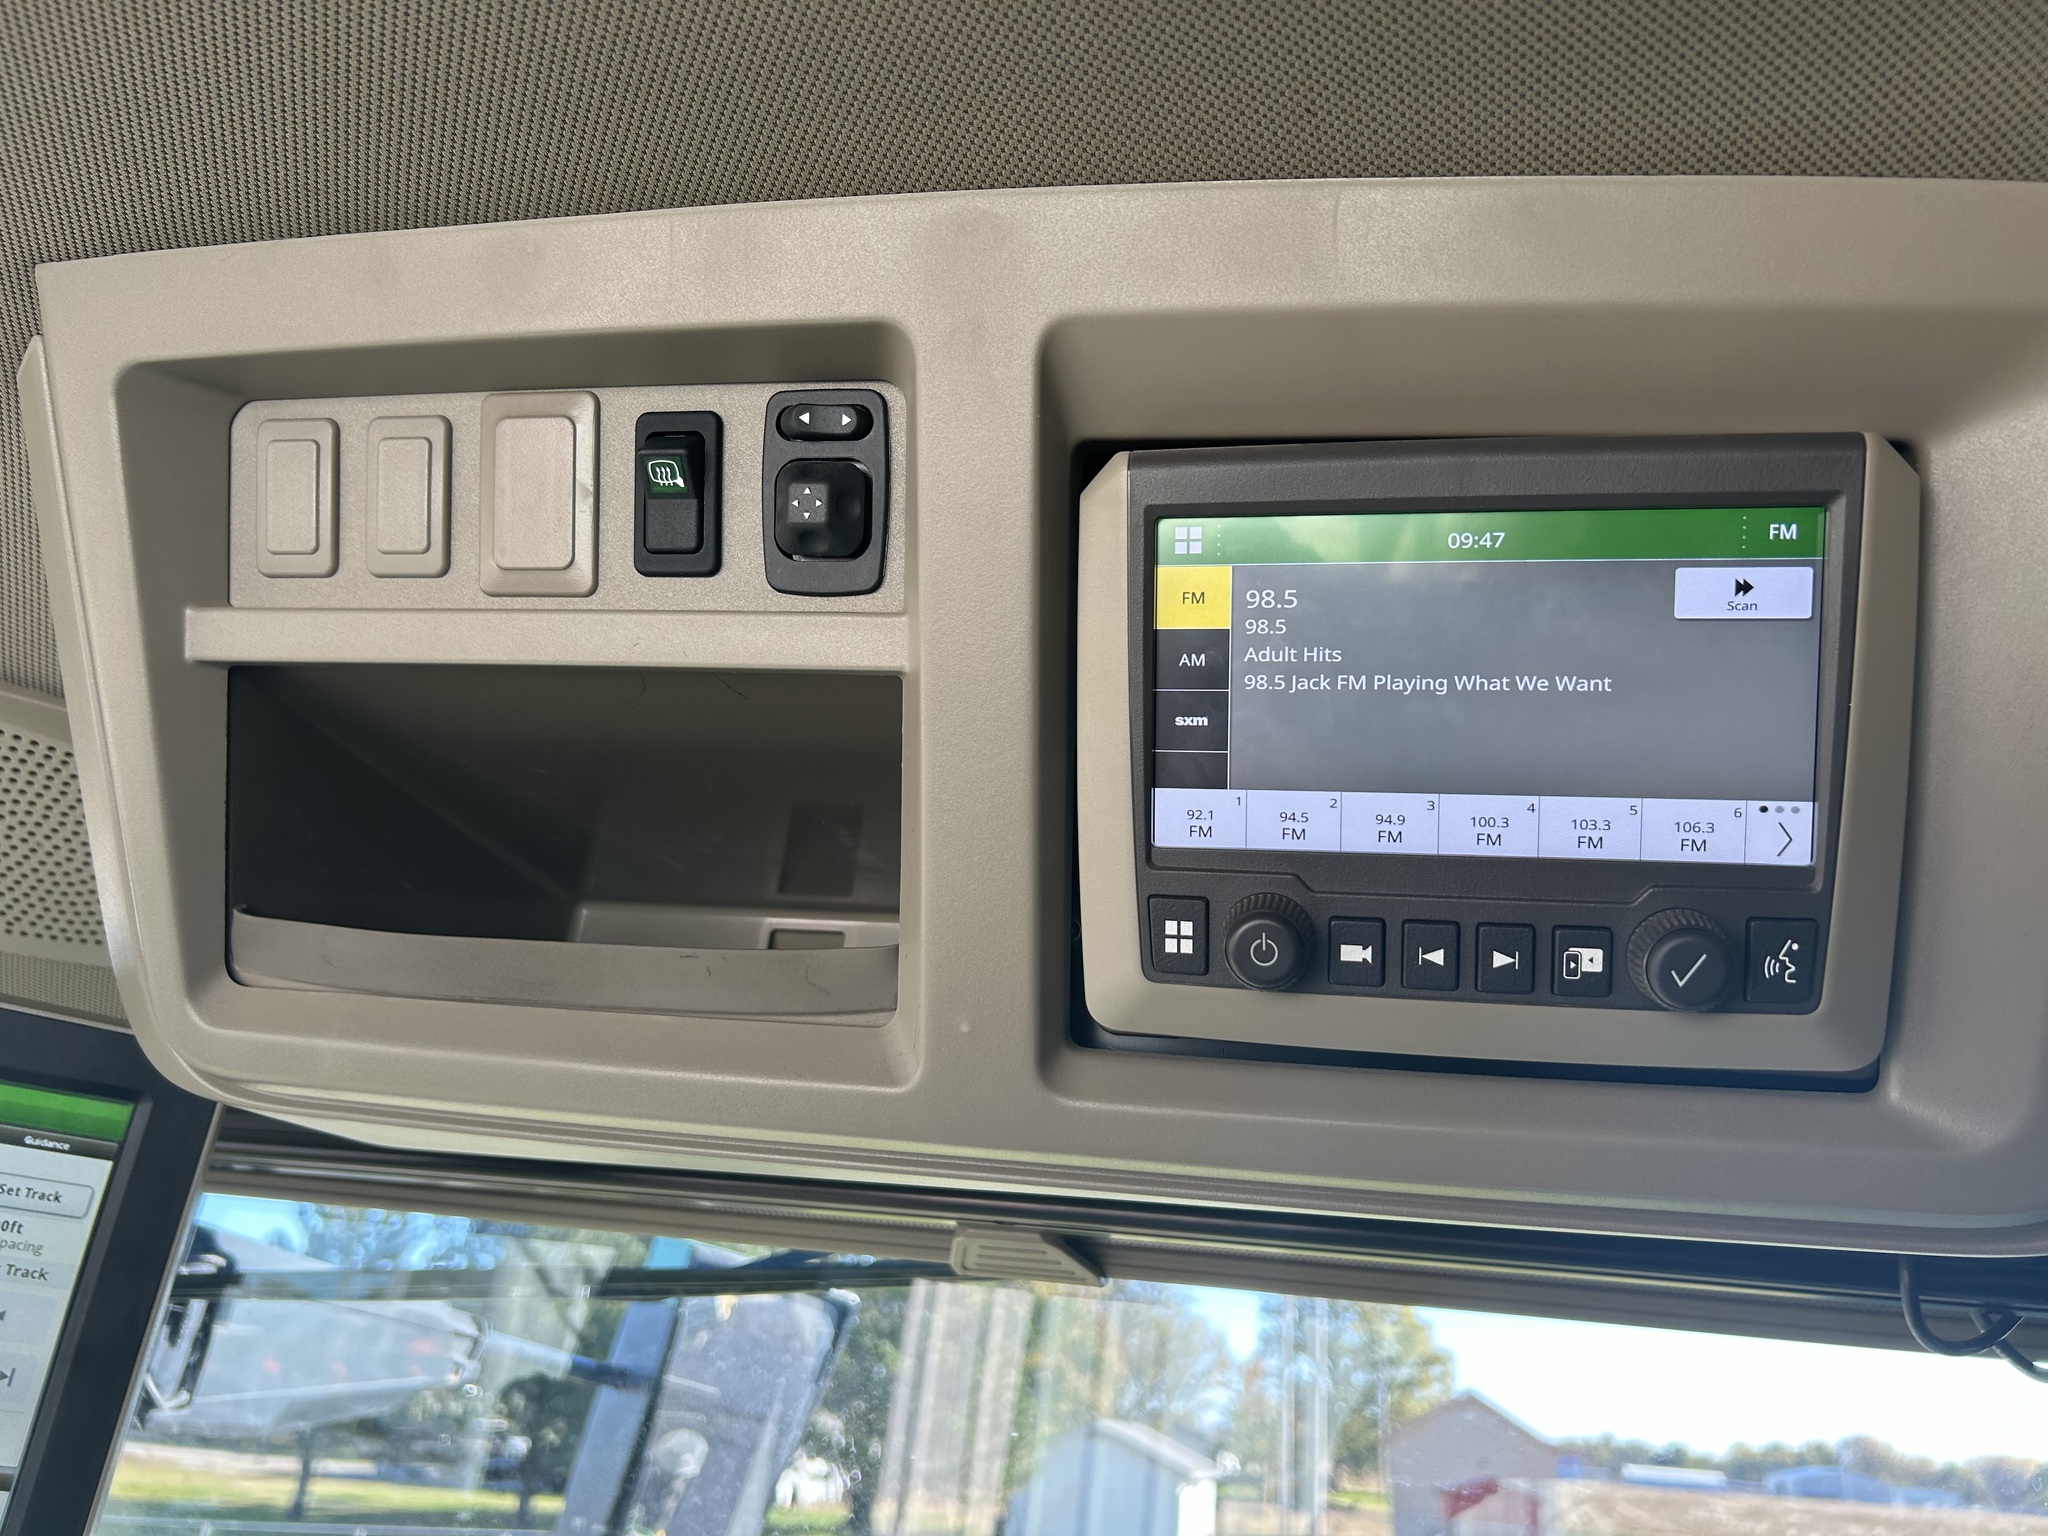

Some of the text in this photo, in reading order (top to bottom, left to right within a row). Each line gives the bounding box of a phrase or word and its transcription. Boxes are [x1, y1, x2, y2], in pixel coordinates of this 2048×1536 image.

[1769, 523, 1797, 540] FM
[1446, 530, 1507, 550] 09:47
[1182, 591, 1205, 605] FM
[1245, 589, 1298, 609] 98.5
[1726, 600, 1758, 611] Scan
[1245, 618, 1287, 635] 98.5
[1178, 653, 1206, 667] AM
[1243, 645, 1342, 663] Adult Hits
[1244, 673, 1613, 695] 98.5 Jack FM Playing What We Want
[1174, 716, 1209, 727] sxm
[1329, 798, 1338, 809] 2
[1426, 800, 1435, 811] 3
[1526, 802, 1536, 814] 4
[1629, 804, 1638, 816] 5
[1186, 809, 1213, 821] 92.1
[1279, 811, 1309, 823] 94.5
[1375, 813, 1406, 826] 94.9
[1733, 807, 1743, 818] 6
[1470, 816, 1510, 829] 100.3
[1571, 818, 1611, 831] 103.3
[1674, 821, 1715, 834] 106.3
[1189, 825, 1213, 838] FM
[1282, 827, 1306, 841] FM
[1378, 830, 1402, 844] FM
[1476, 832, 1502, 847] FM
[1577, 835, 1603, 850] FM
[1680, 838, 1707, 852] FM
[24, 1135, 71, 1151] Guidance
[25, 1187, 62, 1203] Track
[6, 1263, 49, 1281] Track
